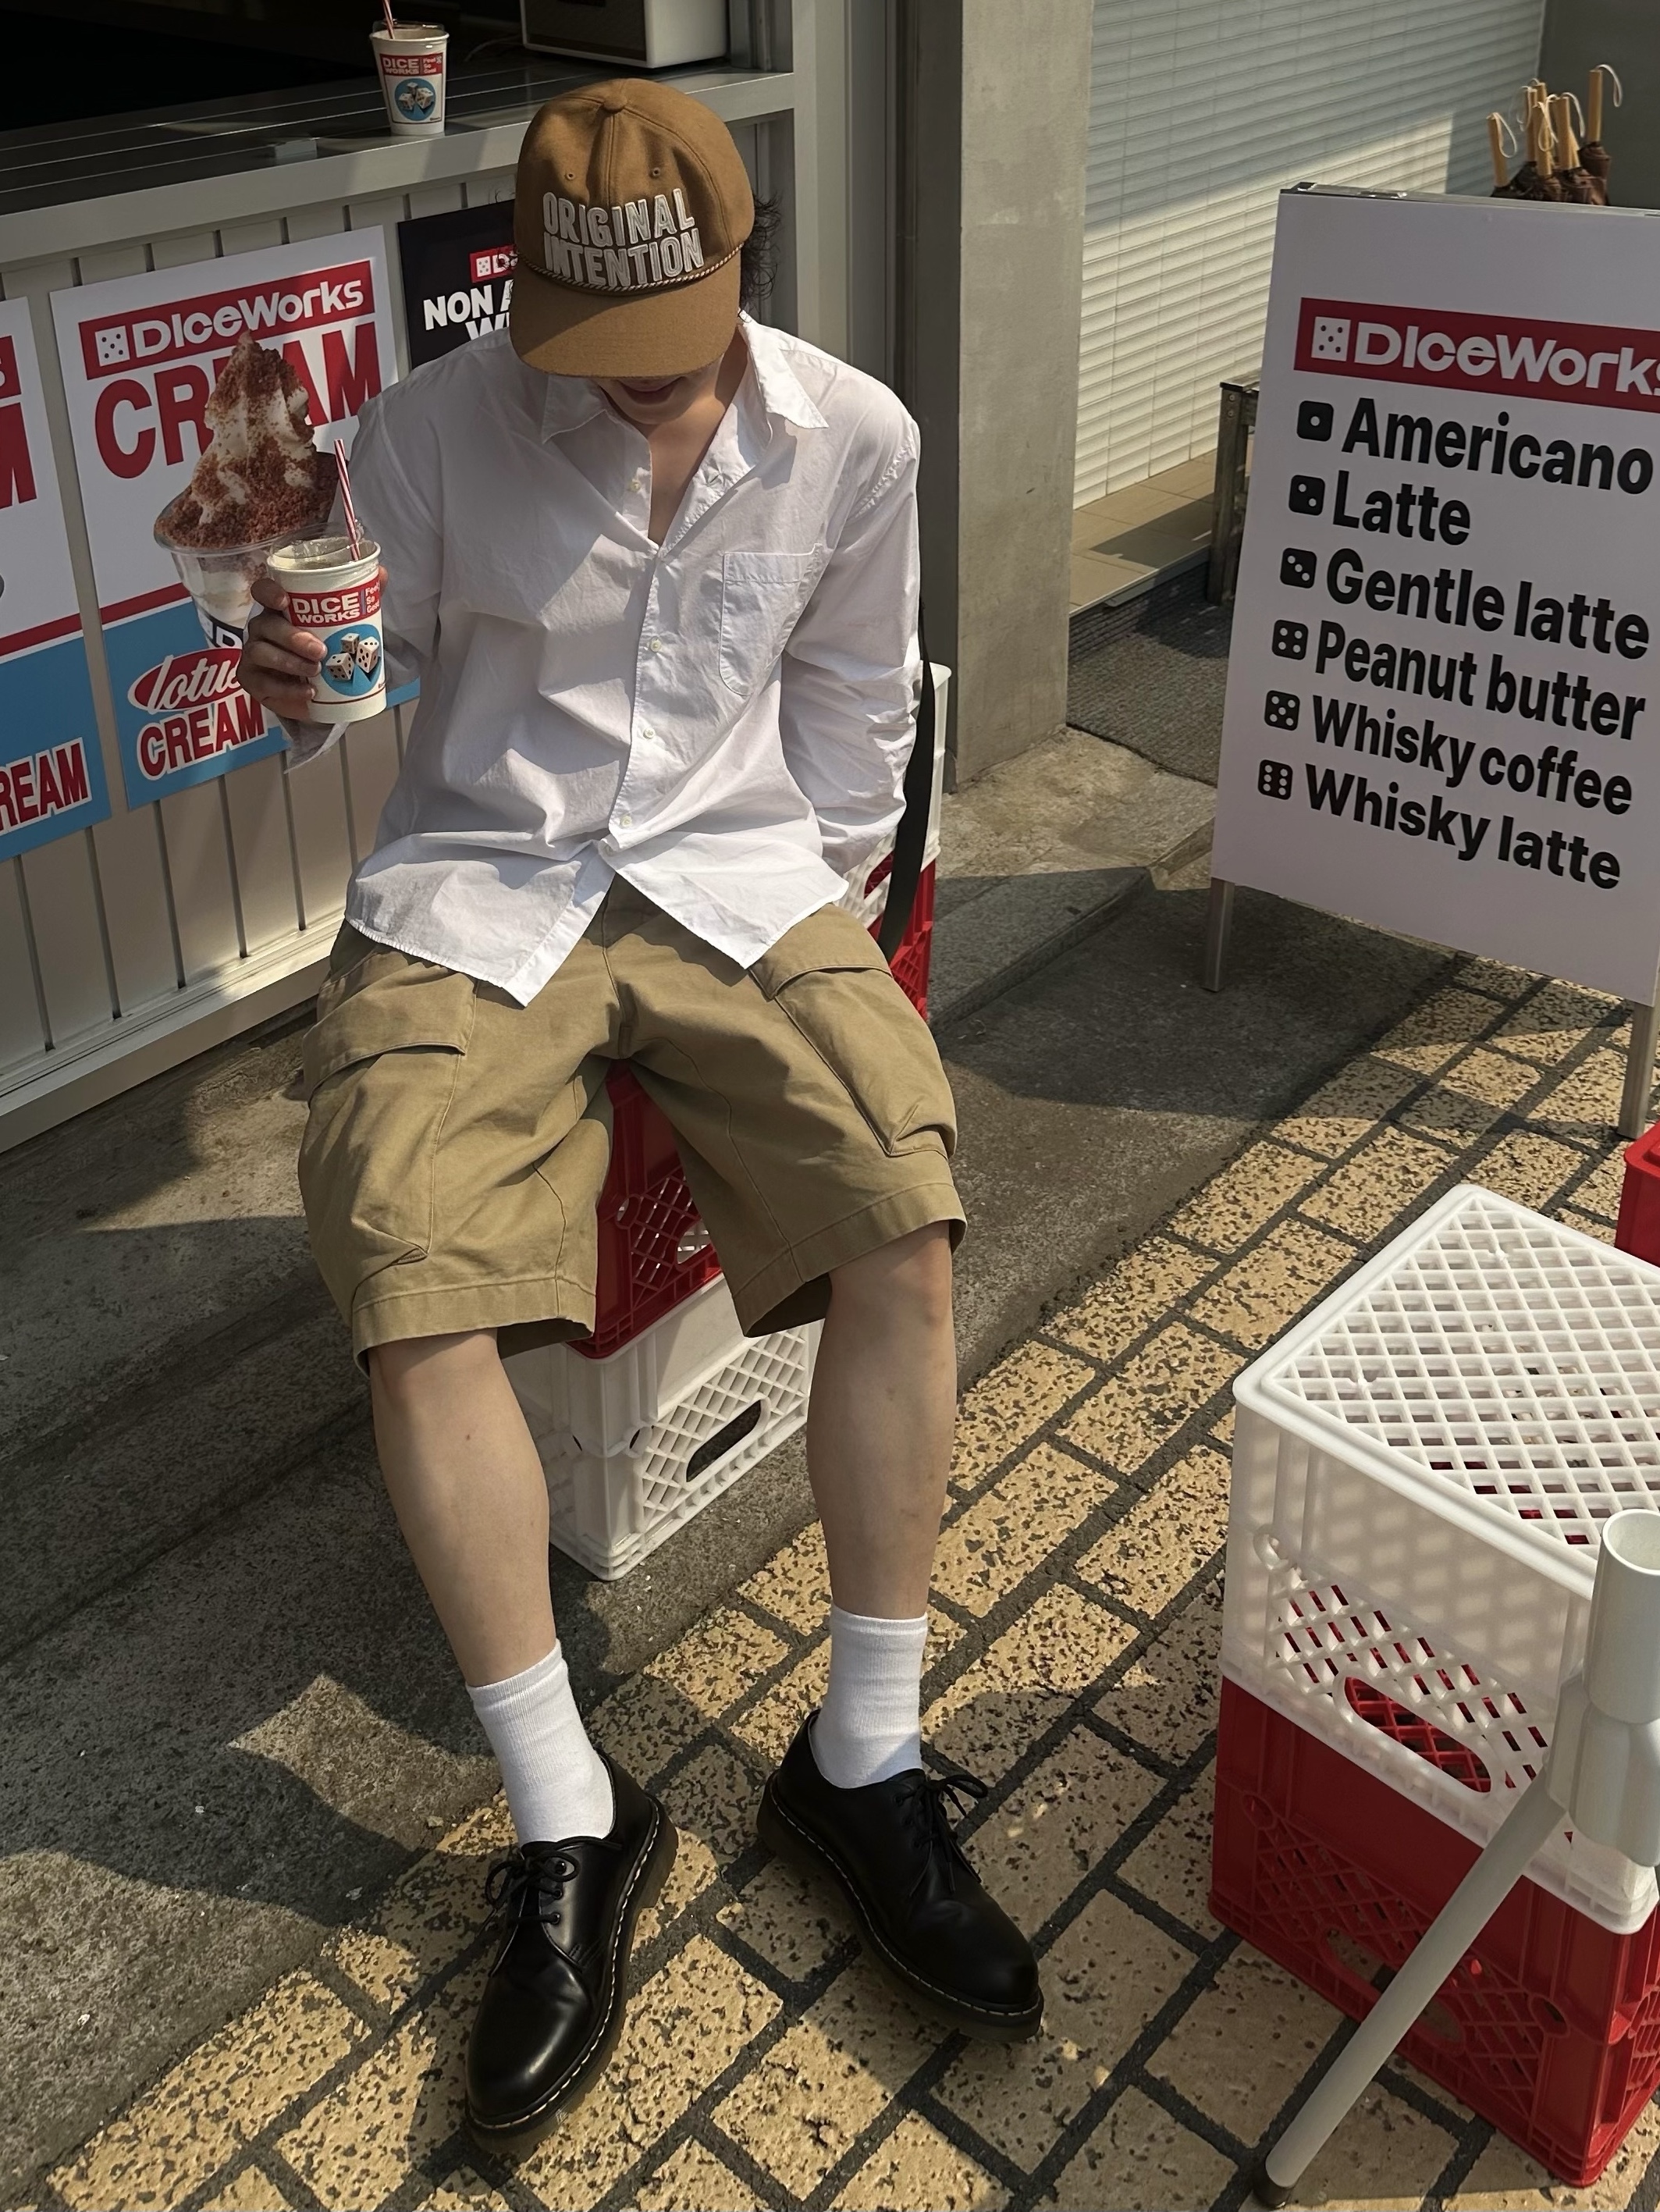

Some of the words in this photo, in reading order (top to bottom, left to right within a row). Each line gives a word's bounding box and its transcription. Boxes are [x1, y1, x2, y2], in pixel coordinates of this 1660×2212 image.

[382, 58, 419, 69] DICE
[543, 188, 695, 247] ORIGINAL
[543, 228, 705, 288] INTENTION
[423, 285, 493, 330] NON
[95, 322, 382, 479] CRAM
[1342, 397, 1653, 494] Americano
[1332, 470, 1470, 546] Latte
[292, 592, 359, 613] DICE
[297, 608, 361, 624] WORKS
[1327, 548, 1505, 632] Gentle
[1514, 581, 1649, 660] latte
[1315, 620, 1477, 706] Peanut
[1486, 653, 1646, 741] butter
[140, 693, 265, 777] CREAM
[1313, 695, 1476, 788] Whisky
[1479, 745, 1632, 815] coffee
[1305, 763, 1491, 862] Whisky
[1498, 815, 1621, 890] latte
